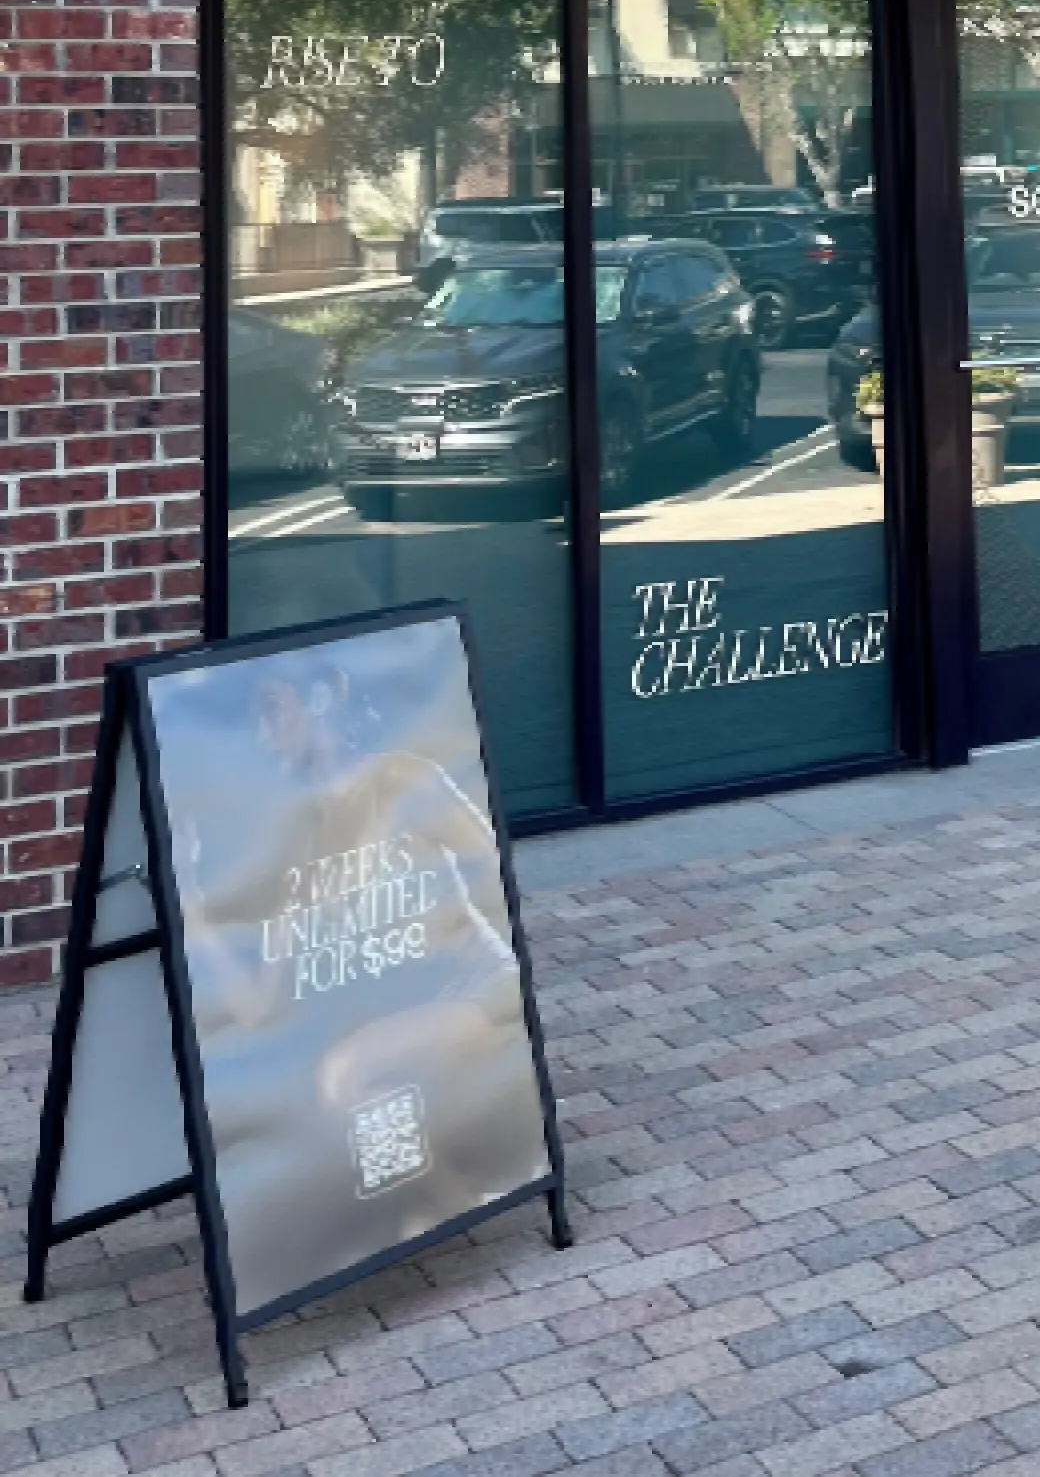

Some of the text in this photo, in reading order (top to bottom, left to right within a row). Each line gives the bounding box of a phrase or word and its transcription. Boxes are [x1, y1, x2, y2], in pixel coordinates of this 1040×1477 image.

[376, 32, 444, 86] TO
[632, 576, 724, 639] THE
[631, 610, 889, 698] CHALLENGE
[284, 833, 414, 912] 2 WEEKS
[261, 871, 437, 963] UNLIMITED
[292, 922, 426, 1000] FOR $99
